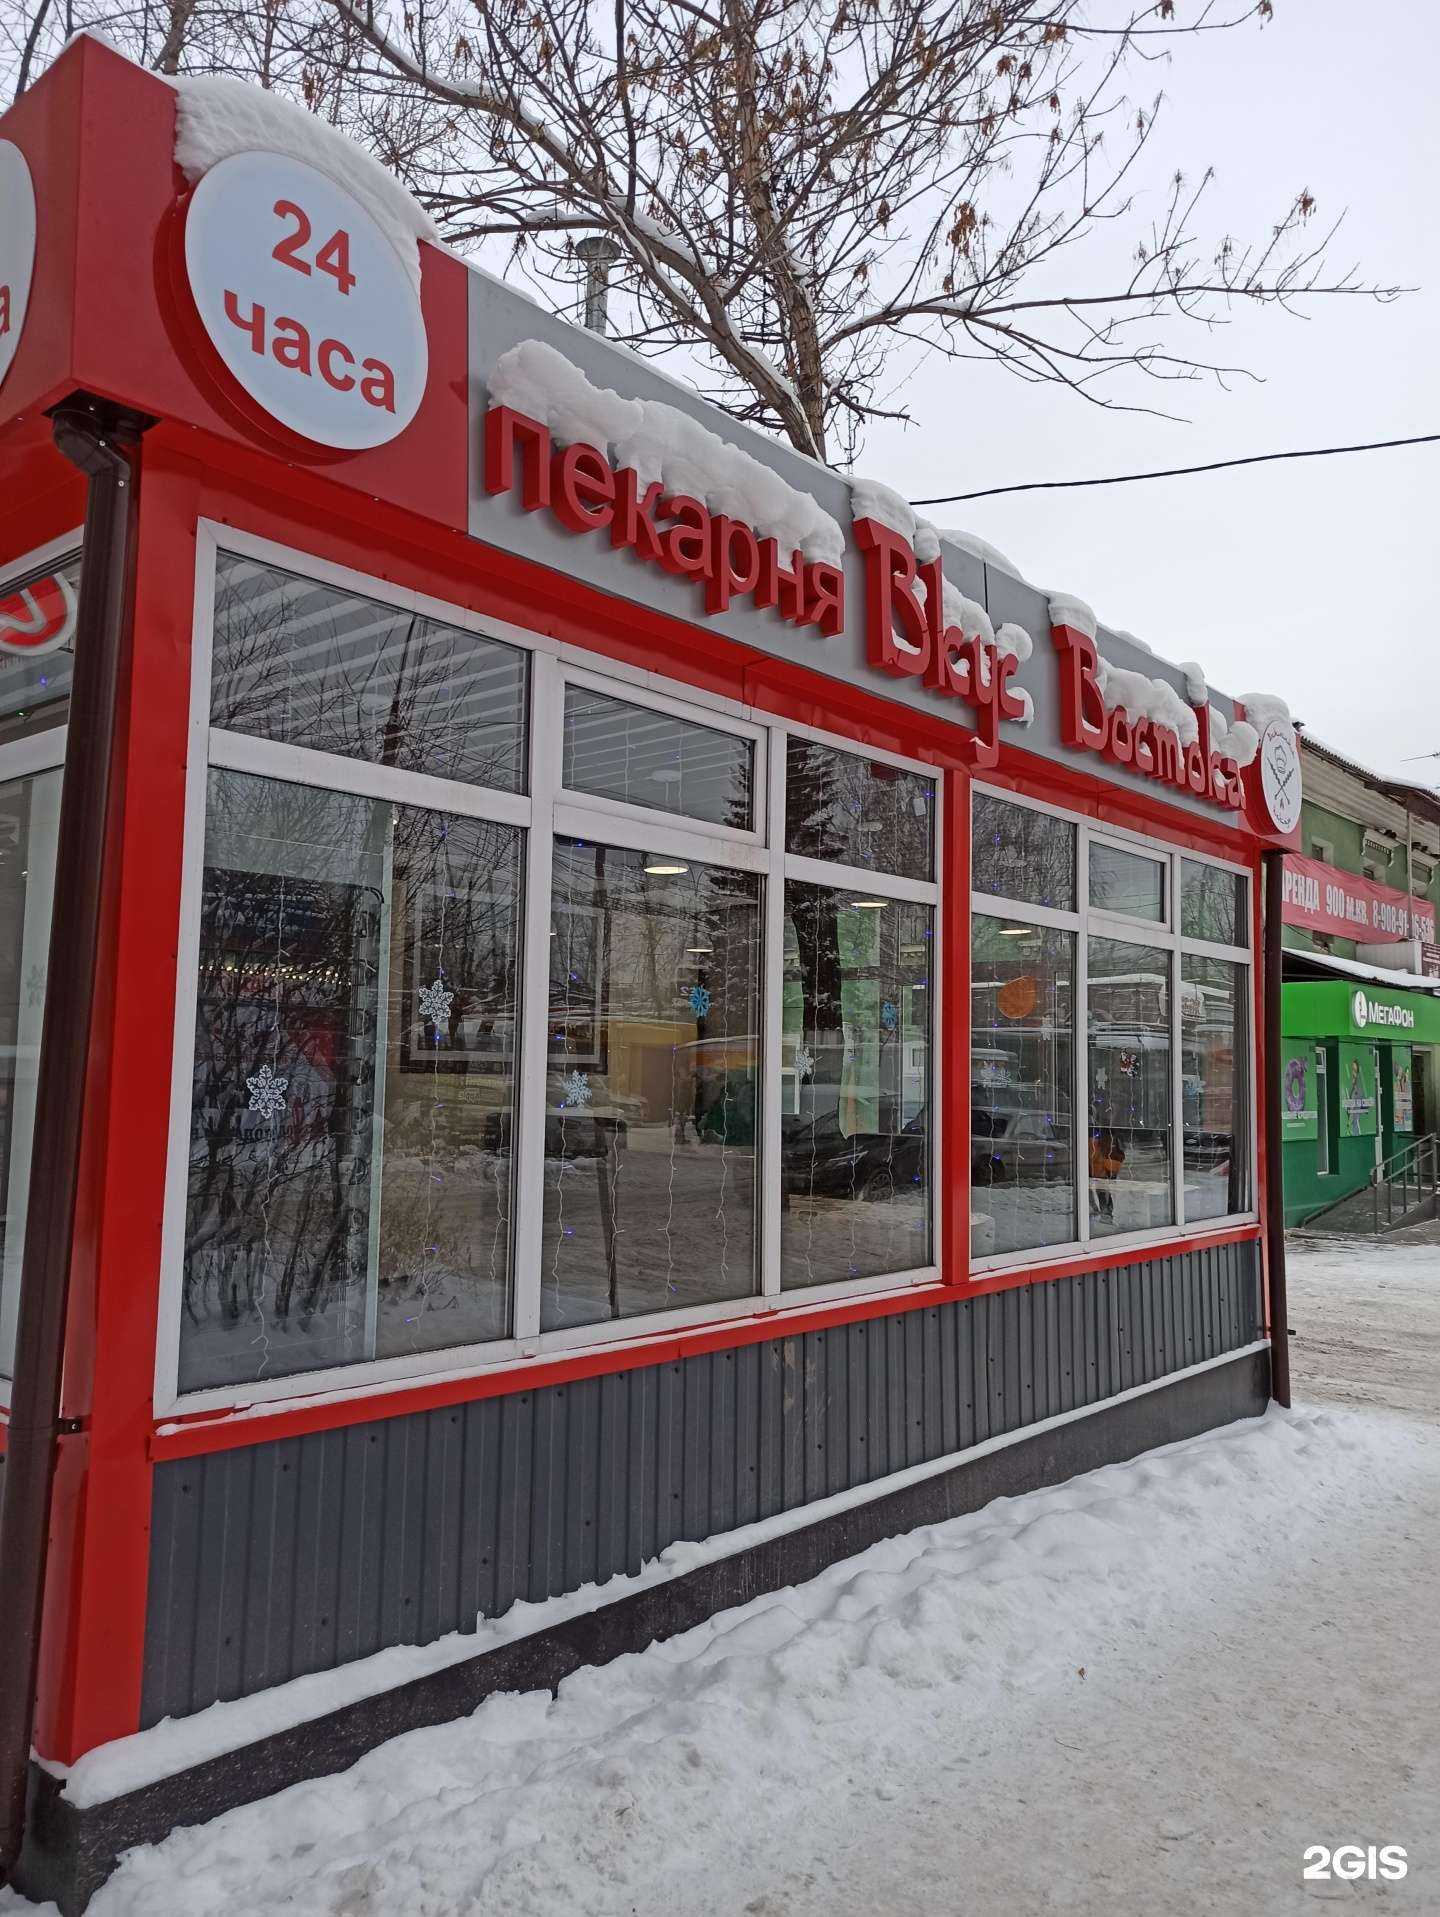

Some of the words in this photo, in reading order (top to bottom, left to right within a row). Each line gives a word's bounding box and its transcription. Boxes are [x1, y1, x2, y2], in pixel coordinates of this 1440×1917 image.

[272, 199, 356, 296] 24
[224, 289, 396, 414] часа
[486, 405, 844, 637] пекарня
[854, 517, 1027, 768] Вкус
[1052, 624, 1246, 810] Востока
[1326, 884, 1344, 919] 900
